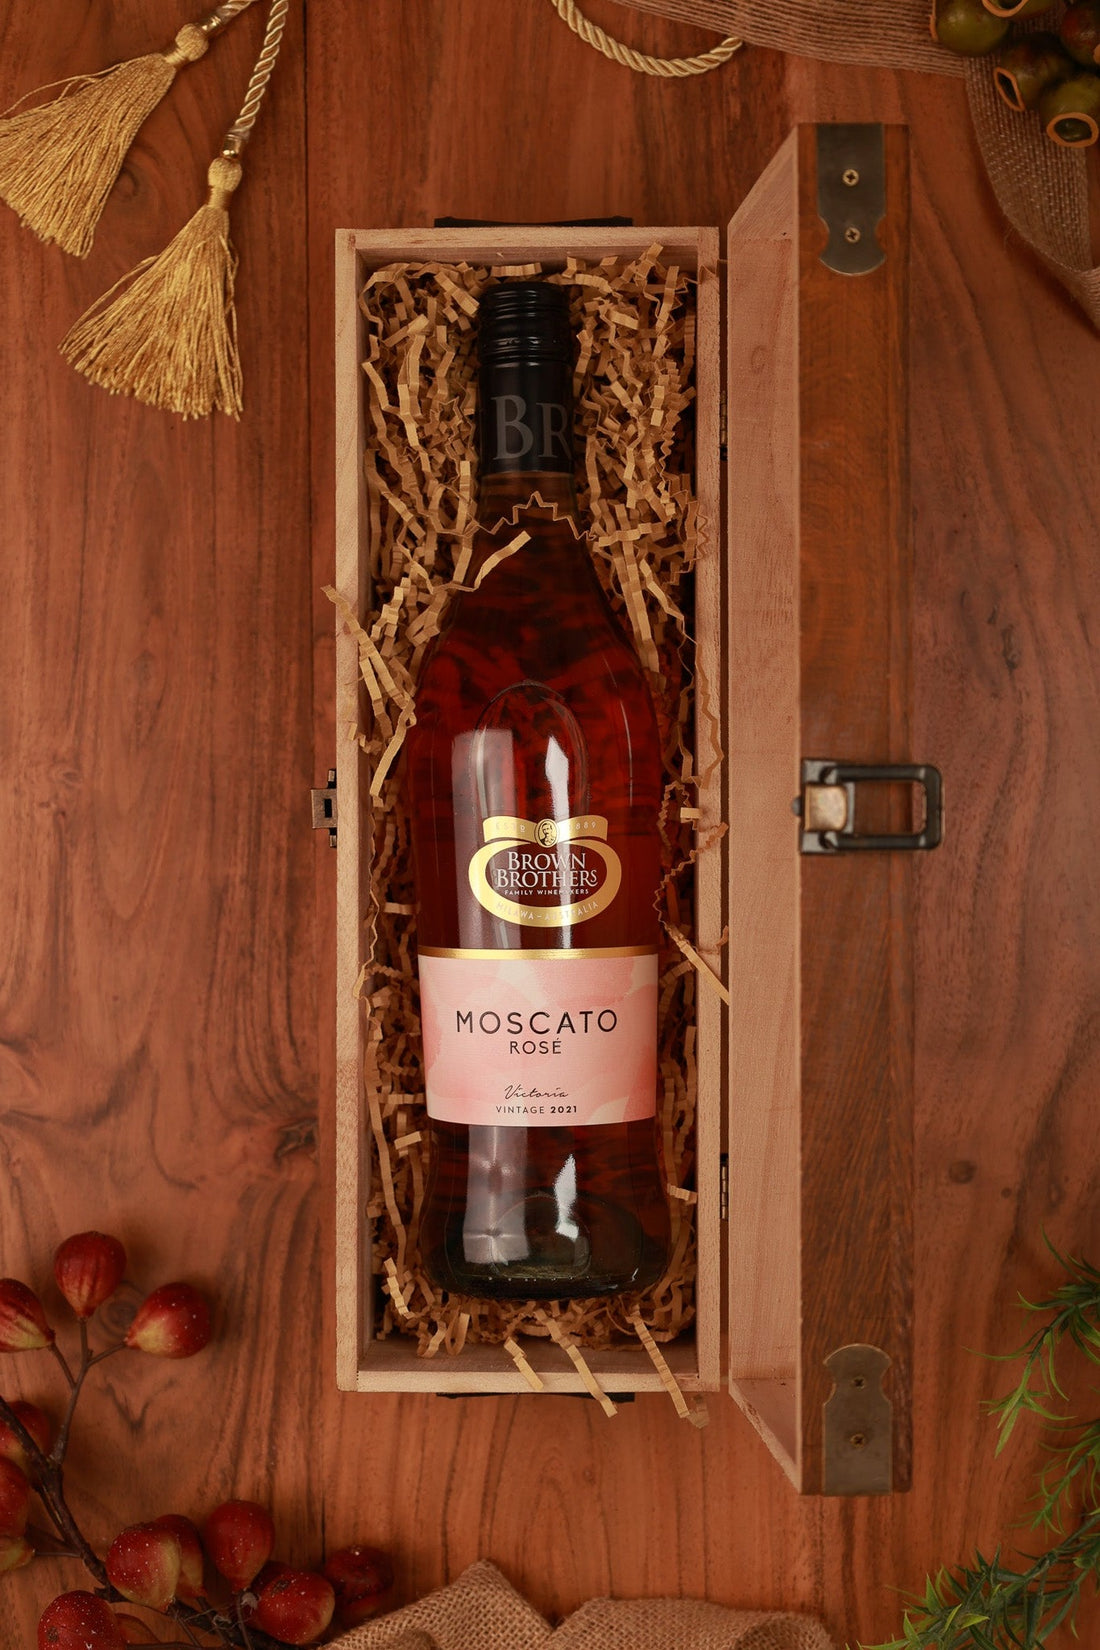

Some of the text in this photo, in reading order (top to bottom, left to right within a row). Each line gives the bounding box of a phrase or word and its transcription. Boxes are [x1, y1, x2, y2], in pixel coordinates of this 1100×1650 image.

[507, 851, 586, 871] BROWN
[495, 869, 599, 888] BROTHERS
[456, 1009, 618, 1035] MOSCATO
[509, 1037, 562, 1055] ROSÉ
[504, 1084, 569, 1100] Victoria
[495, 1105, 577, 1114] VINTAGE 2021
